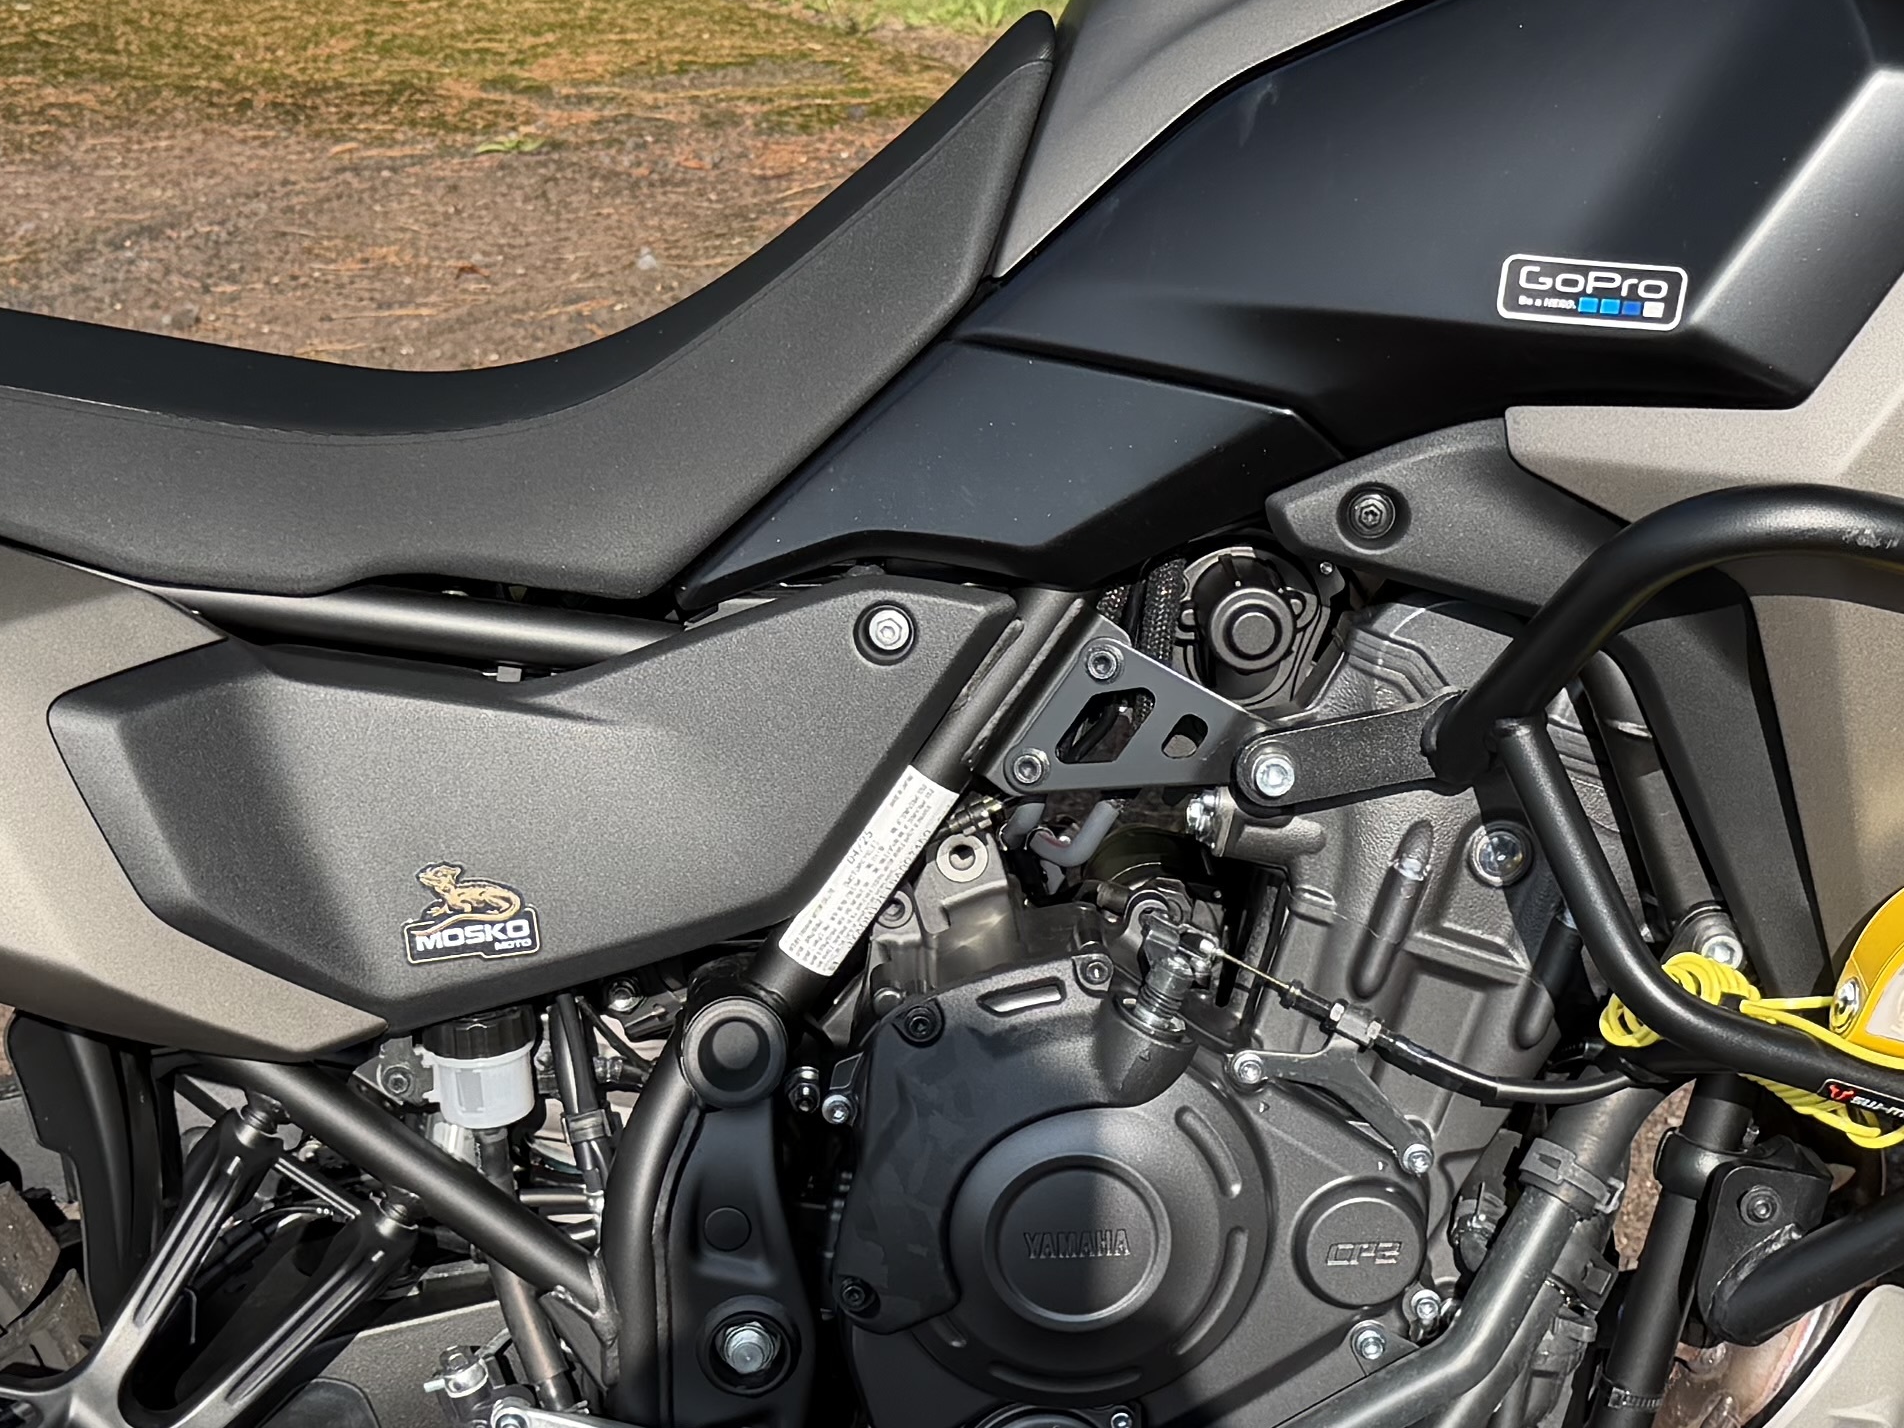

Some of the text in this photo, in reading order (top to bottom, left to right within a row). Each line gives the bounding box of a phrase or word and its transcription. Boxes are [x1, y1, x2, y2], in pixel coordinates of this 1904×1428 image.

[1518, 265, 1669, 300] GoPro
[415, 918, 530, 952] MOSKO
[494, 937, 532, 952] MOTO
[1022, 1228, 1131, 1259] YAMAHA
[1325, 1240, 1402, 1265] CP2
